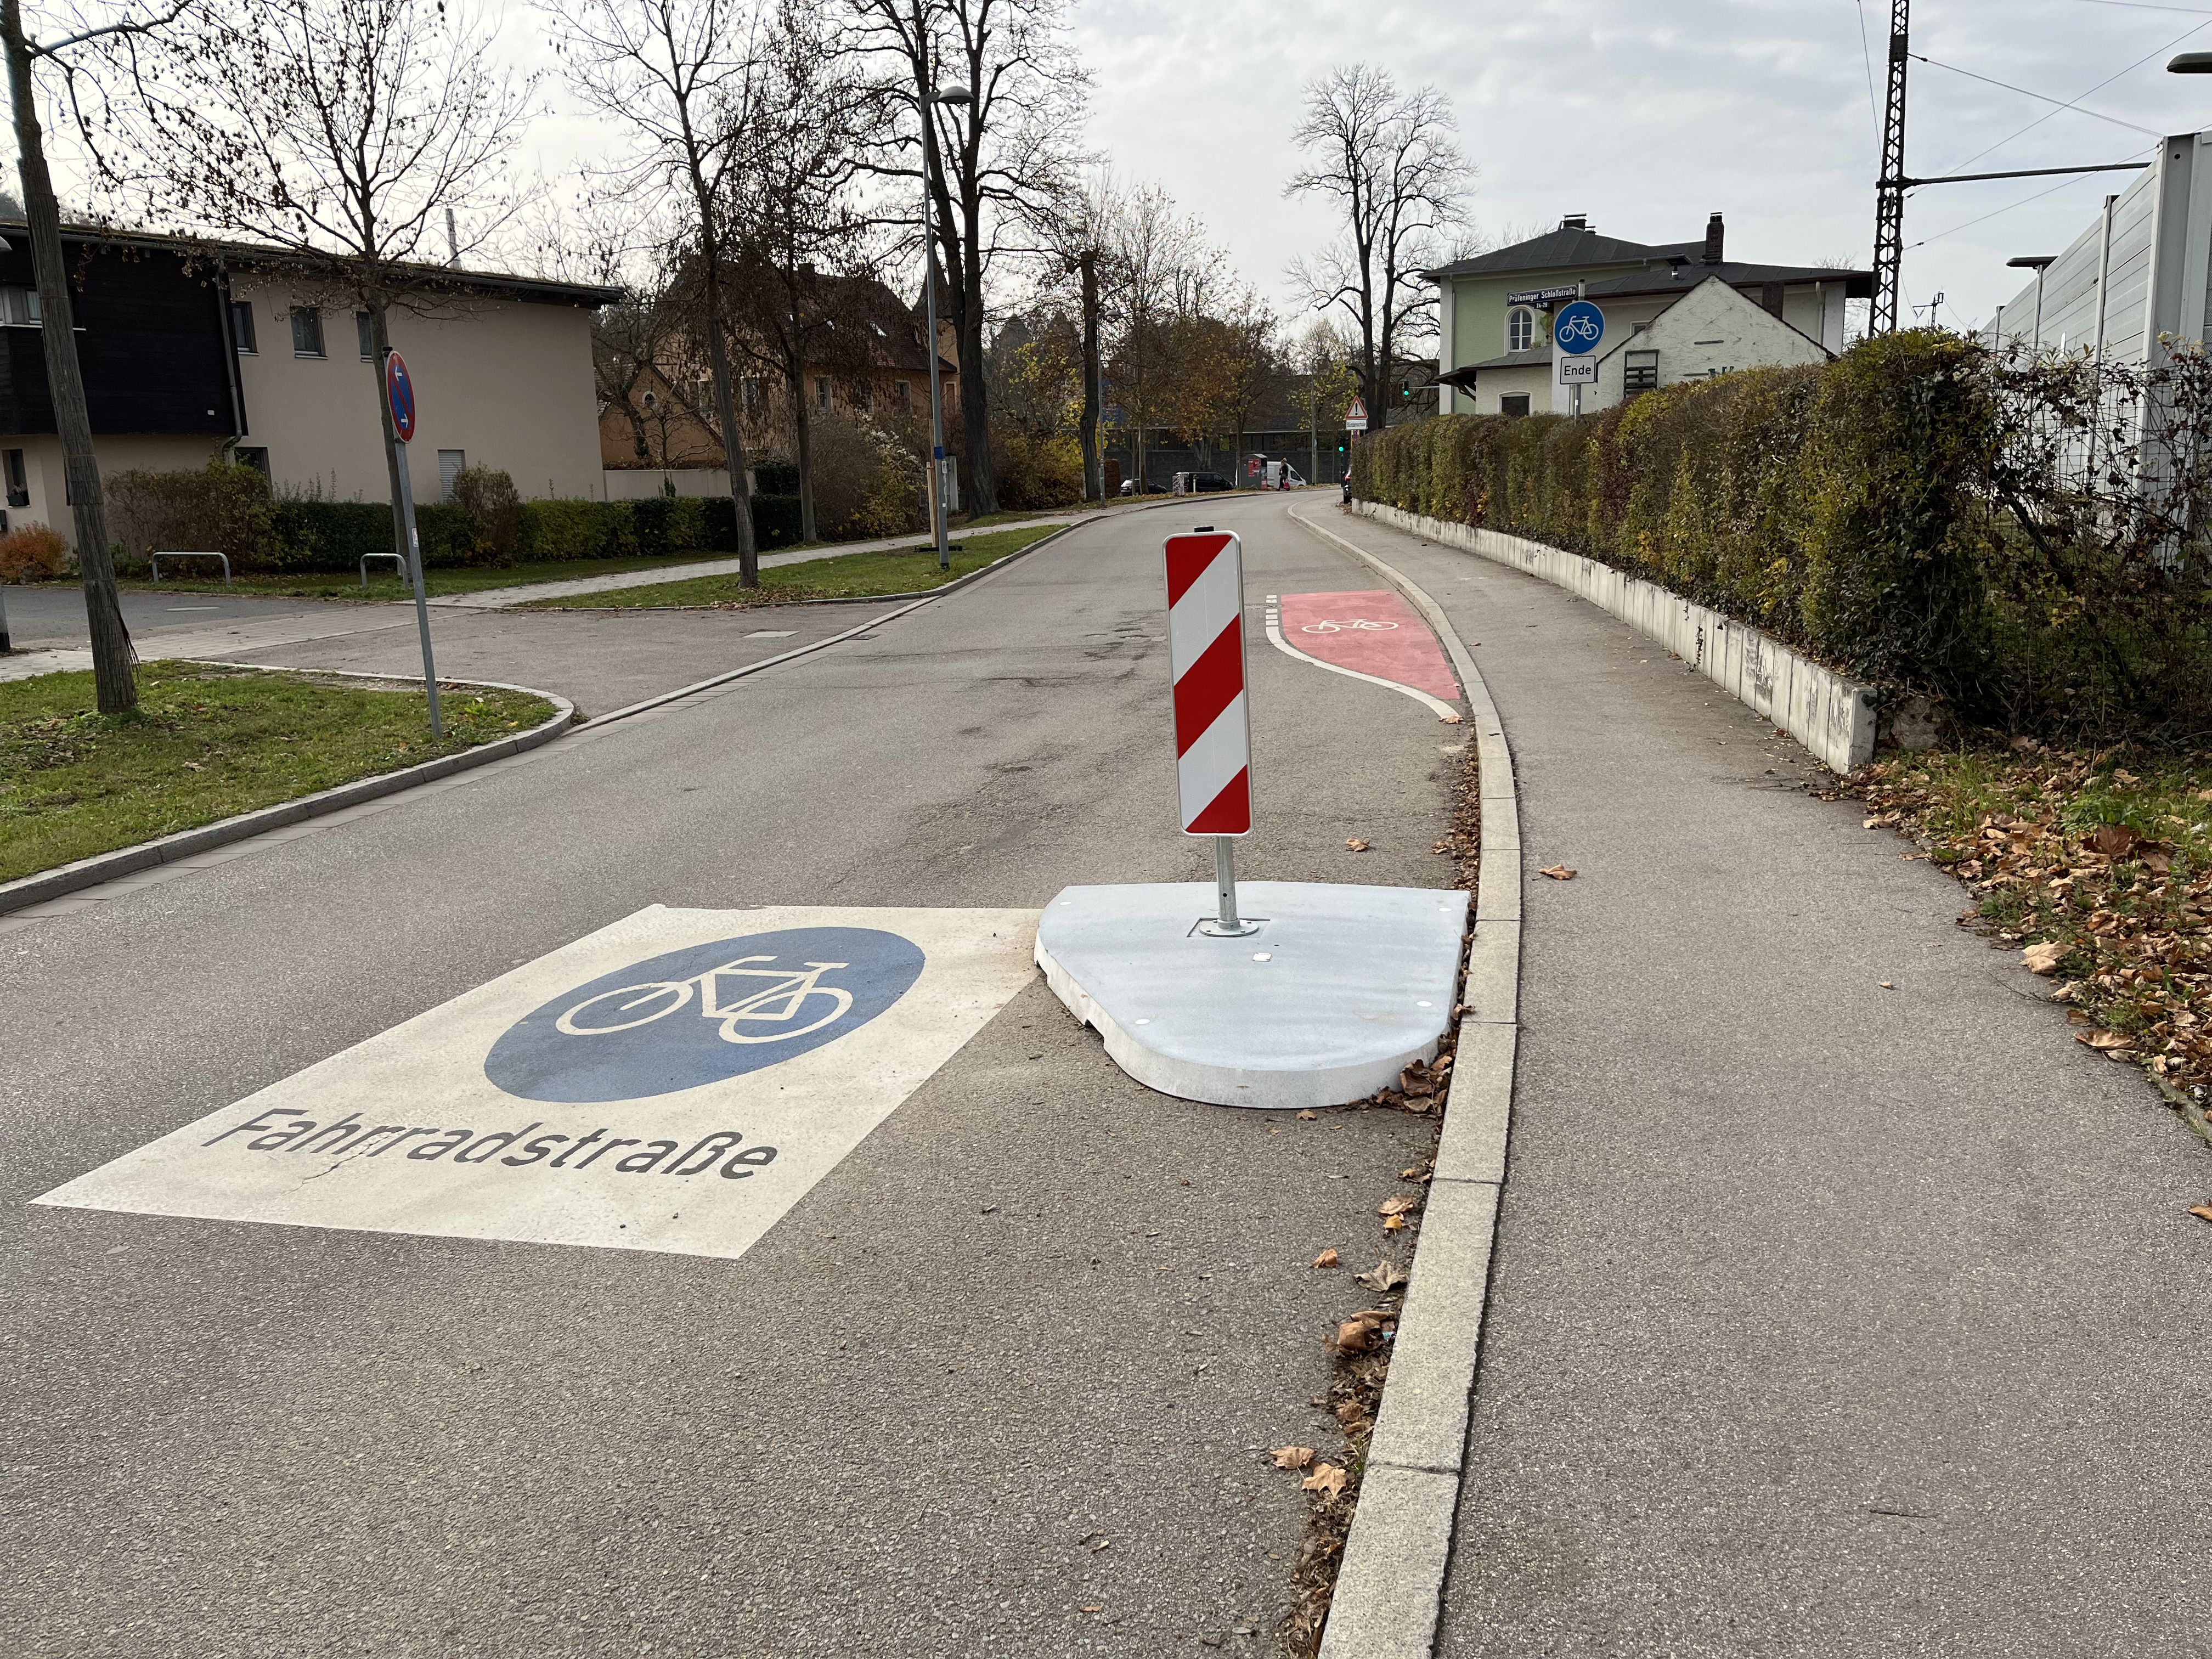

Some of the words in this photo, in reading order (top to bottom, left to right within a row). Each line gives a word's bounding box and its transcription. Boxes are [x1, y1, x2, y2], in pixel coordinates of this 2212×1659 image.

[1509, 294, 1539, 303] Prüfeninger
[1541, 288, 1576, 299] Schloßstraße
[1564, 365, 1592, 375] Ende
[201, 1108, 778, 1180] Fahrradstraße
